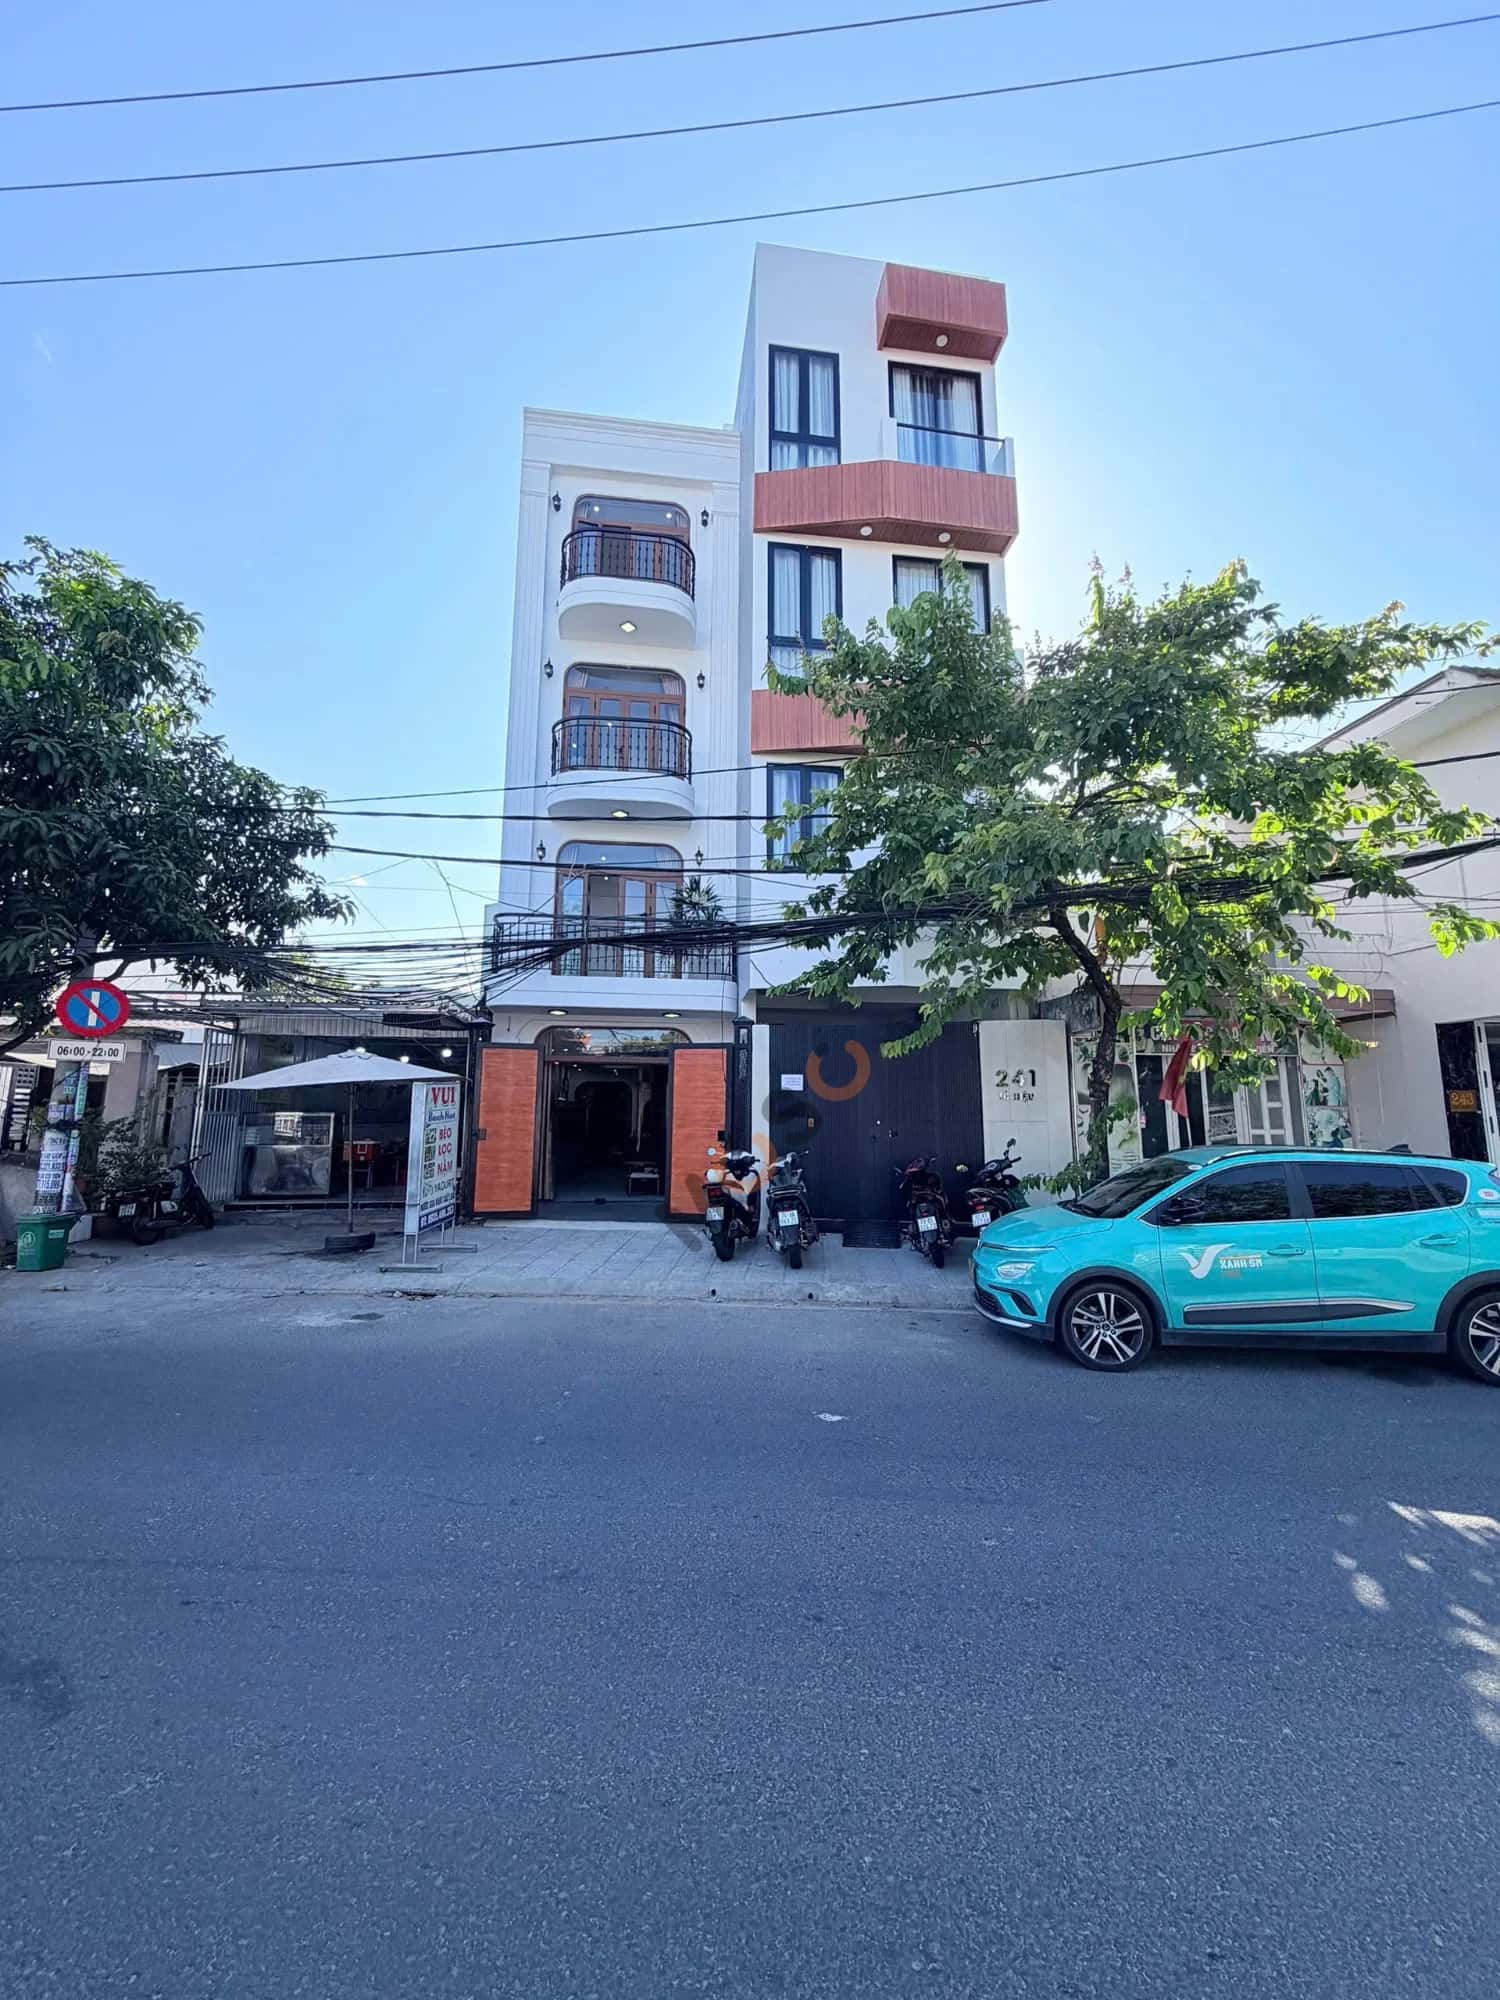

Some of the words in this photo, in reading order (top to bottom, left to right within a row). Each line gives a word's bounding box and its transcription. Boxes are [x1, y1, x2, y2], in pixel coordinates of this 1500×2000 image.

[57, 1046, 85, 1056] 06:00
[92, 1047, 119, 1057] 22:00
[995, 1069, 1035, 1087] 241
[431, 1087, 455, 1104] VUI
[1220, 1259, 1247, 1270] XANH
